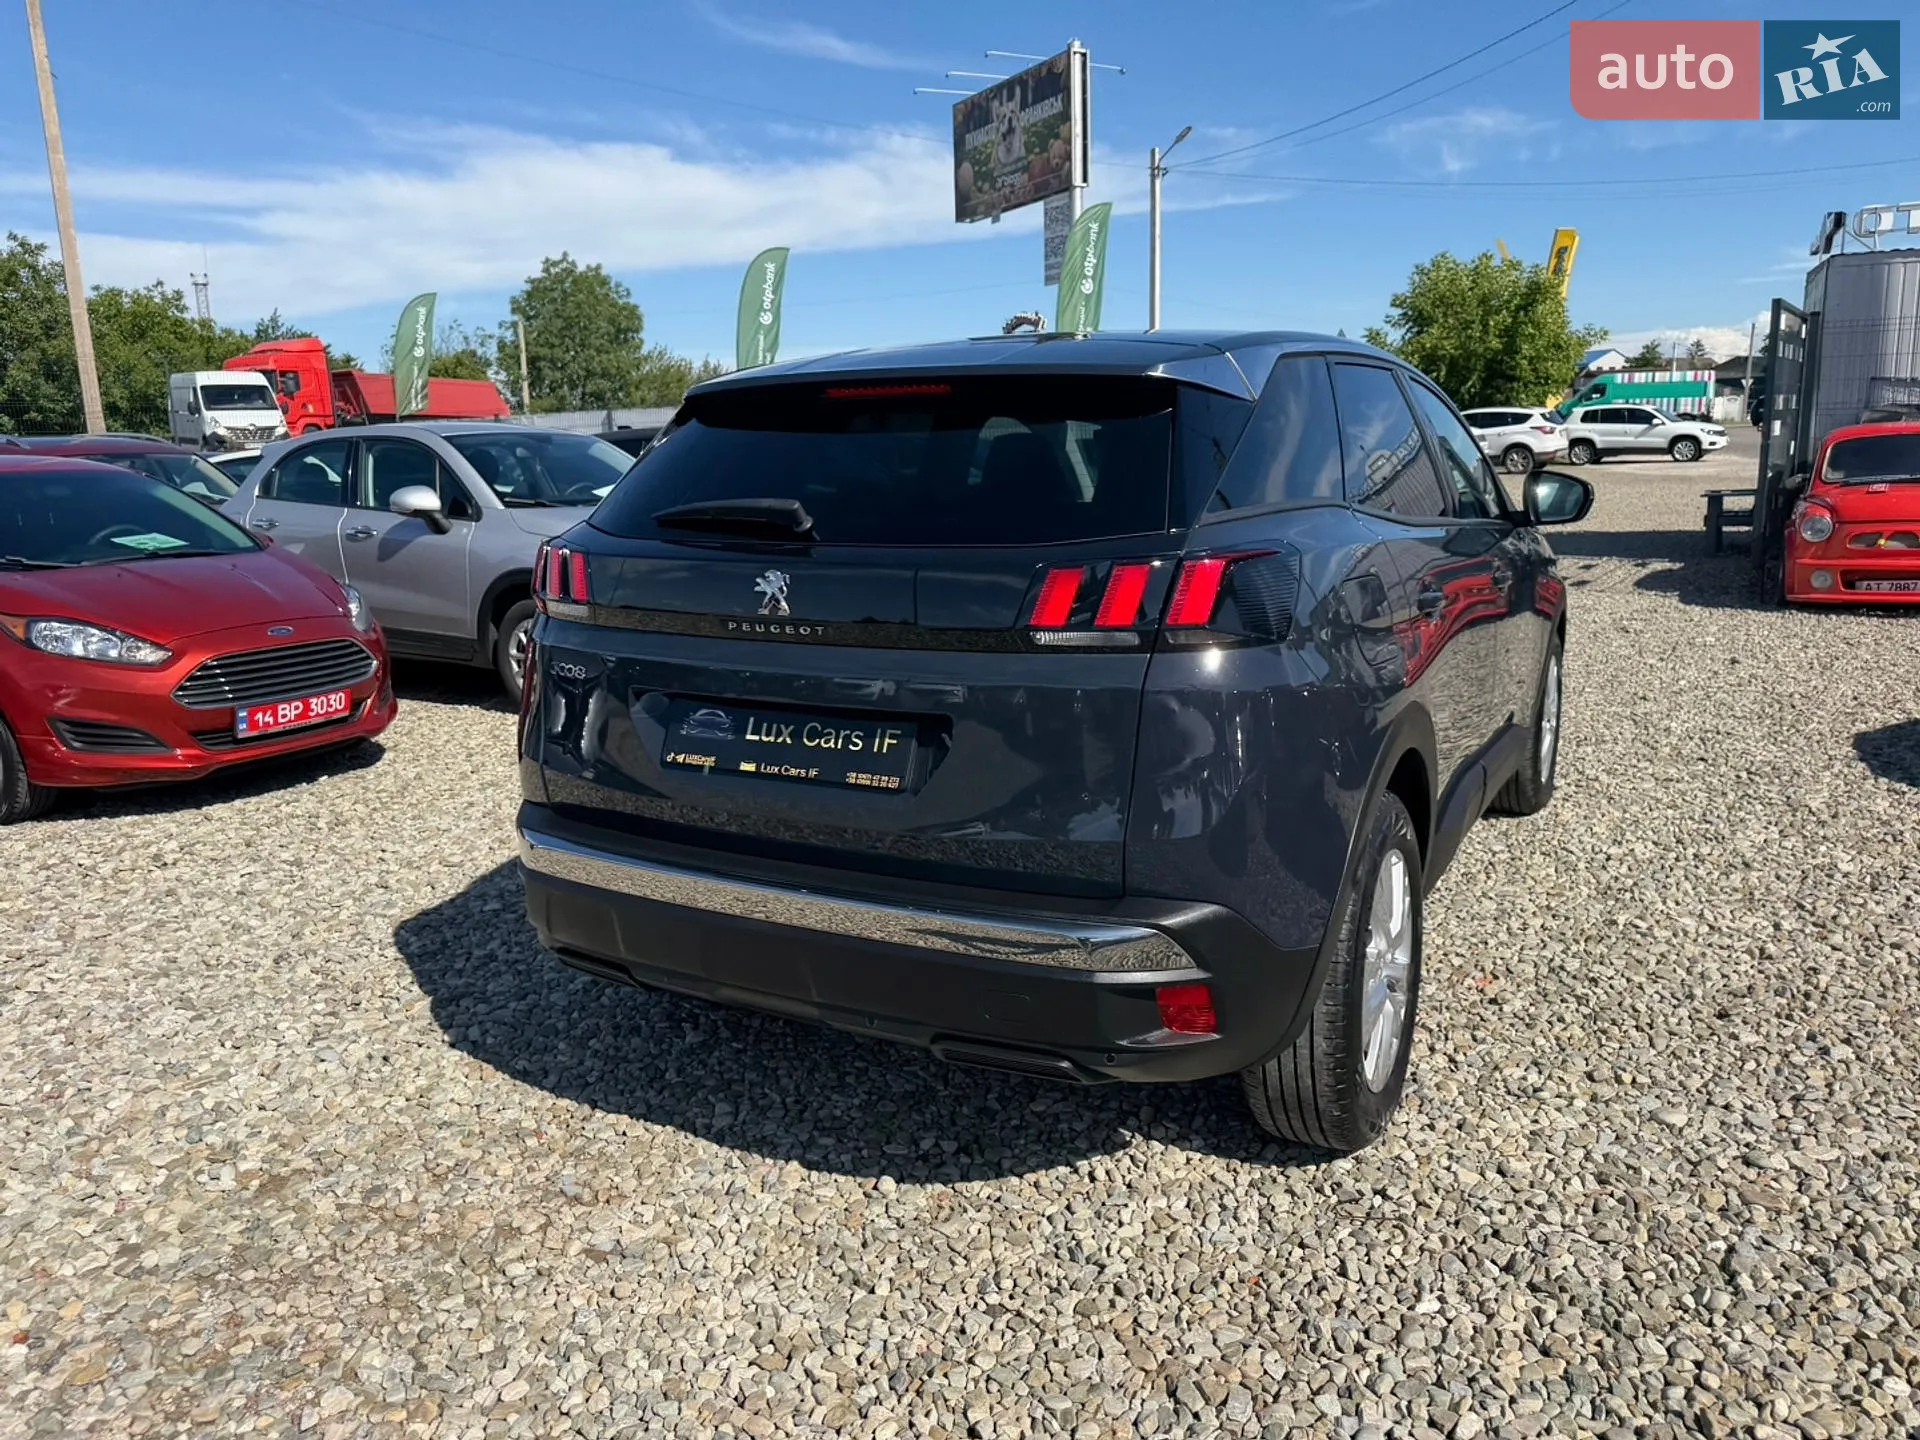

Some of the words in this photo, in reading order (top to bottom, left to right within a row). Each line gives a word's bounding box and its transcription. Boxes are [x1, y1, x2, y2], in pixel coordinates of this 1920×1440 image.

[727, 621, 825, 636] PEUGEOT
[254, 710, 274, 728] 14
[277, 701, 304, 723] BP
[308, 692, 346, 717] 3030
[745, 716, 797, 745] Lux
[802, 721, 864, 751] Cars
[873, 727, 902, 754] IF
[760, 763, 780, 775] Lux
[781, 764, 808, 777] Cars
